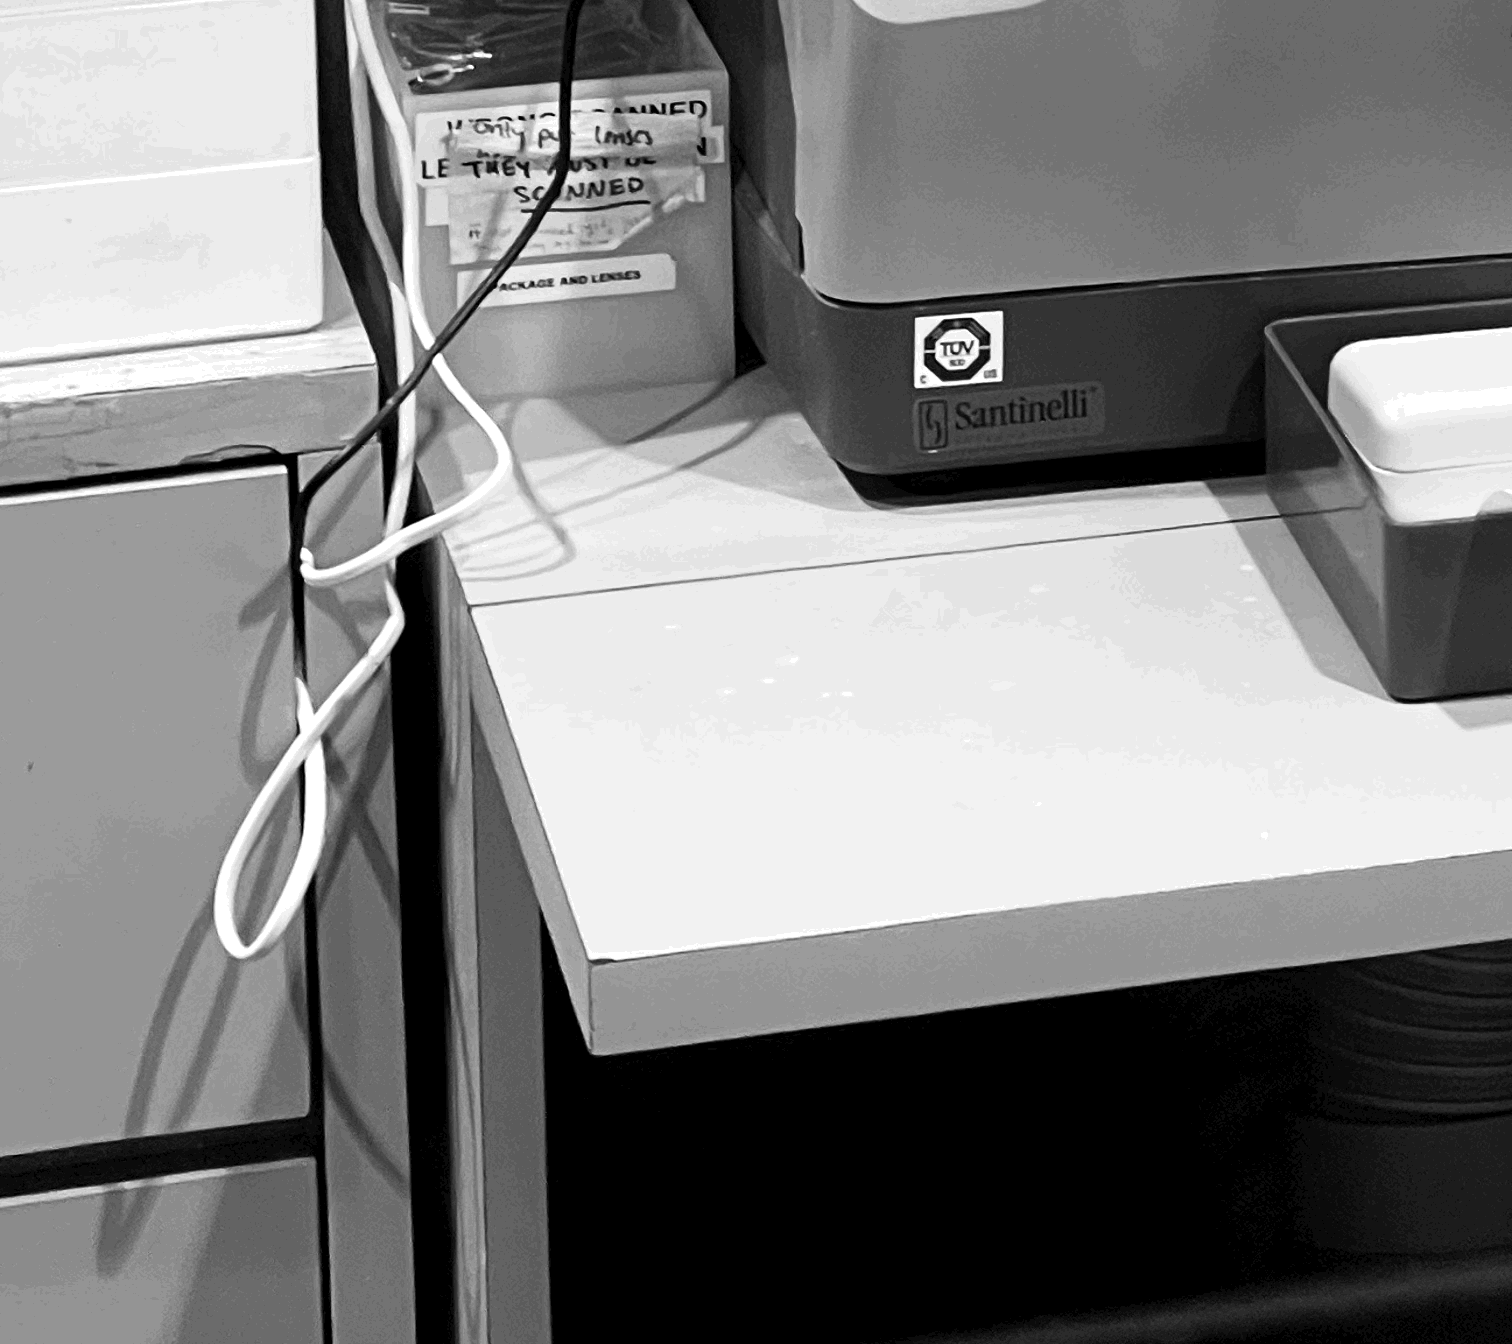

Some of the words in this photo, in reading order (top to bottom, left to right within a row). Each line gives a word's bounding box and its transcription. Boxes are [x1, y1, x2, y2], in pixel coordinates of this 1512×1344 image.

[513, 176, 644, 203] SCNNED
[498, 278, 555, 292] ACKAGE
[955, 389, 1088, 431] Santinelli
